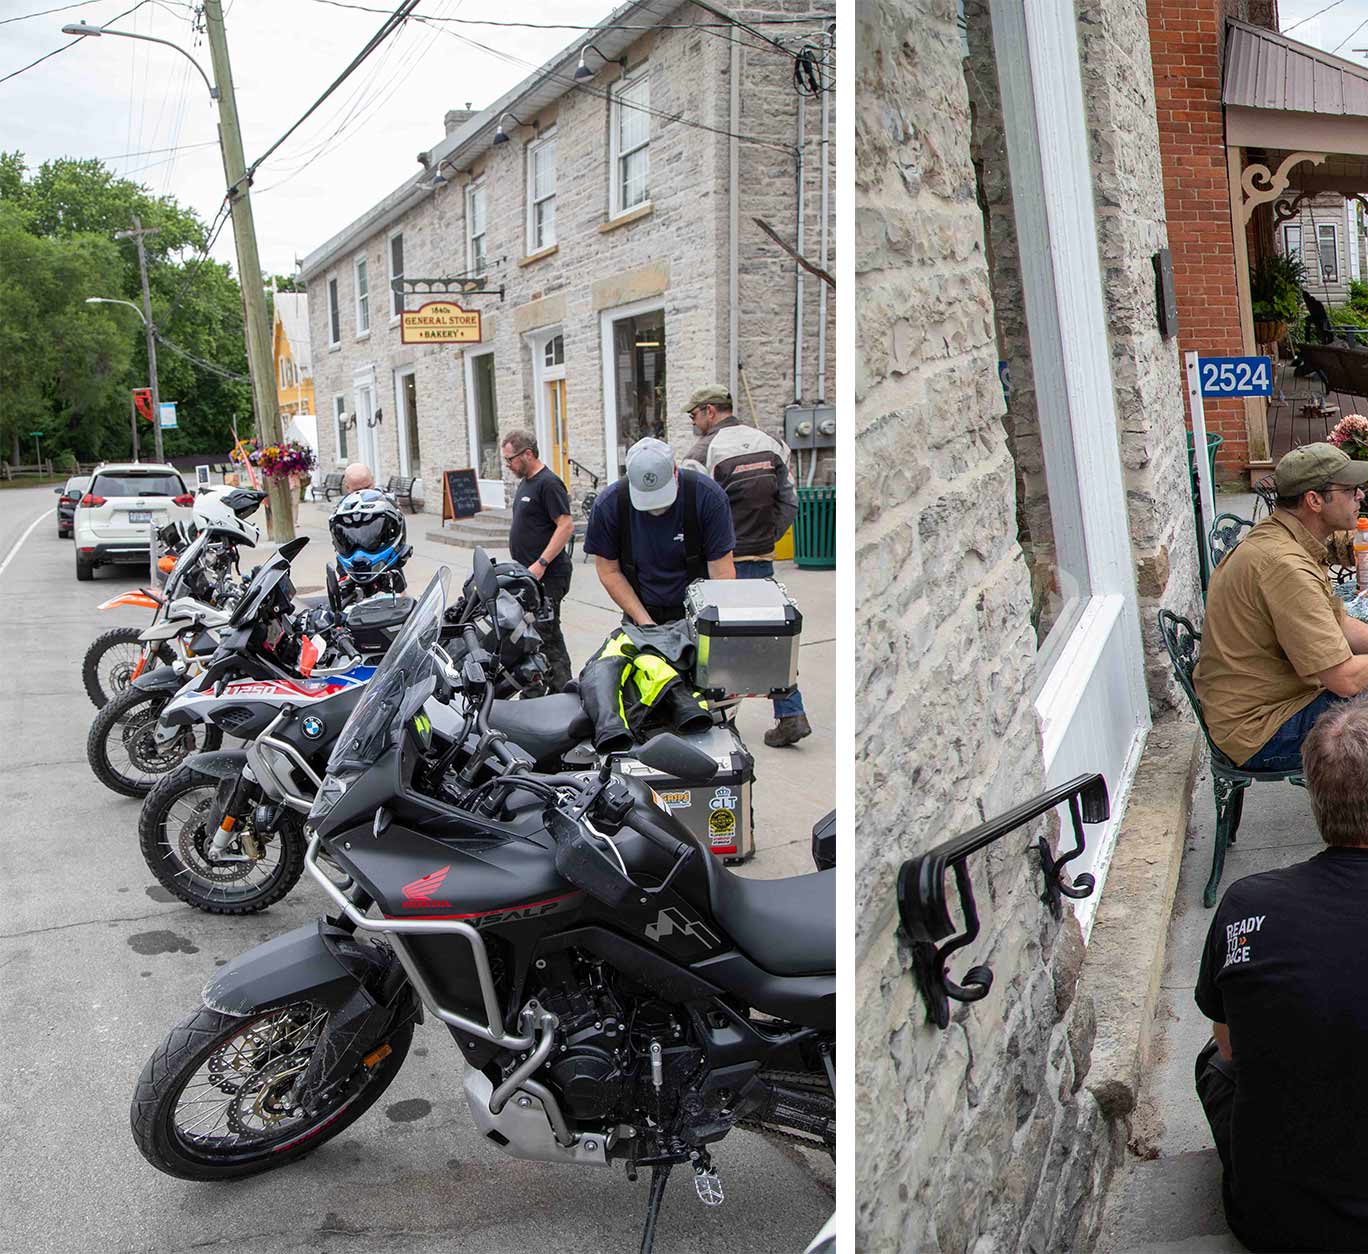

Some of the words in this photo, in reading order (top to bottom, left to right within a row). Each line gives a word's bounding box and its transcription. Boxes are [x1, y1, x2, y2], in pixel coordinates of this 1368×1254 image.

[405, 316, 447, 325] GENERAL
[448, 316, 477, 325] STORE
[424, 329, 458, 338] BAKERY
[1203, 363, 1269, 391] 2524
[710, 797, 737, 809] CLT
[401, 900, 452, 909] HONDA
[1226, 915, 1266, 940] READY
[1227, 936, 1238, 954] TO
